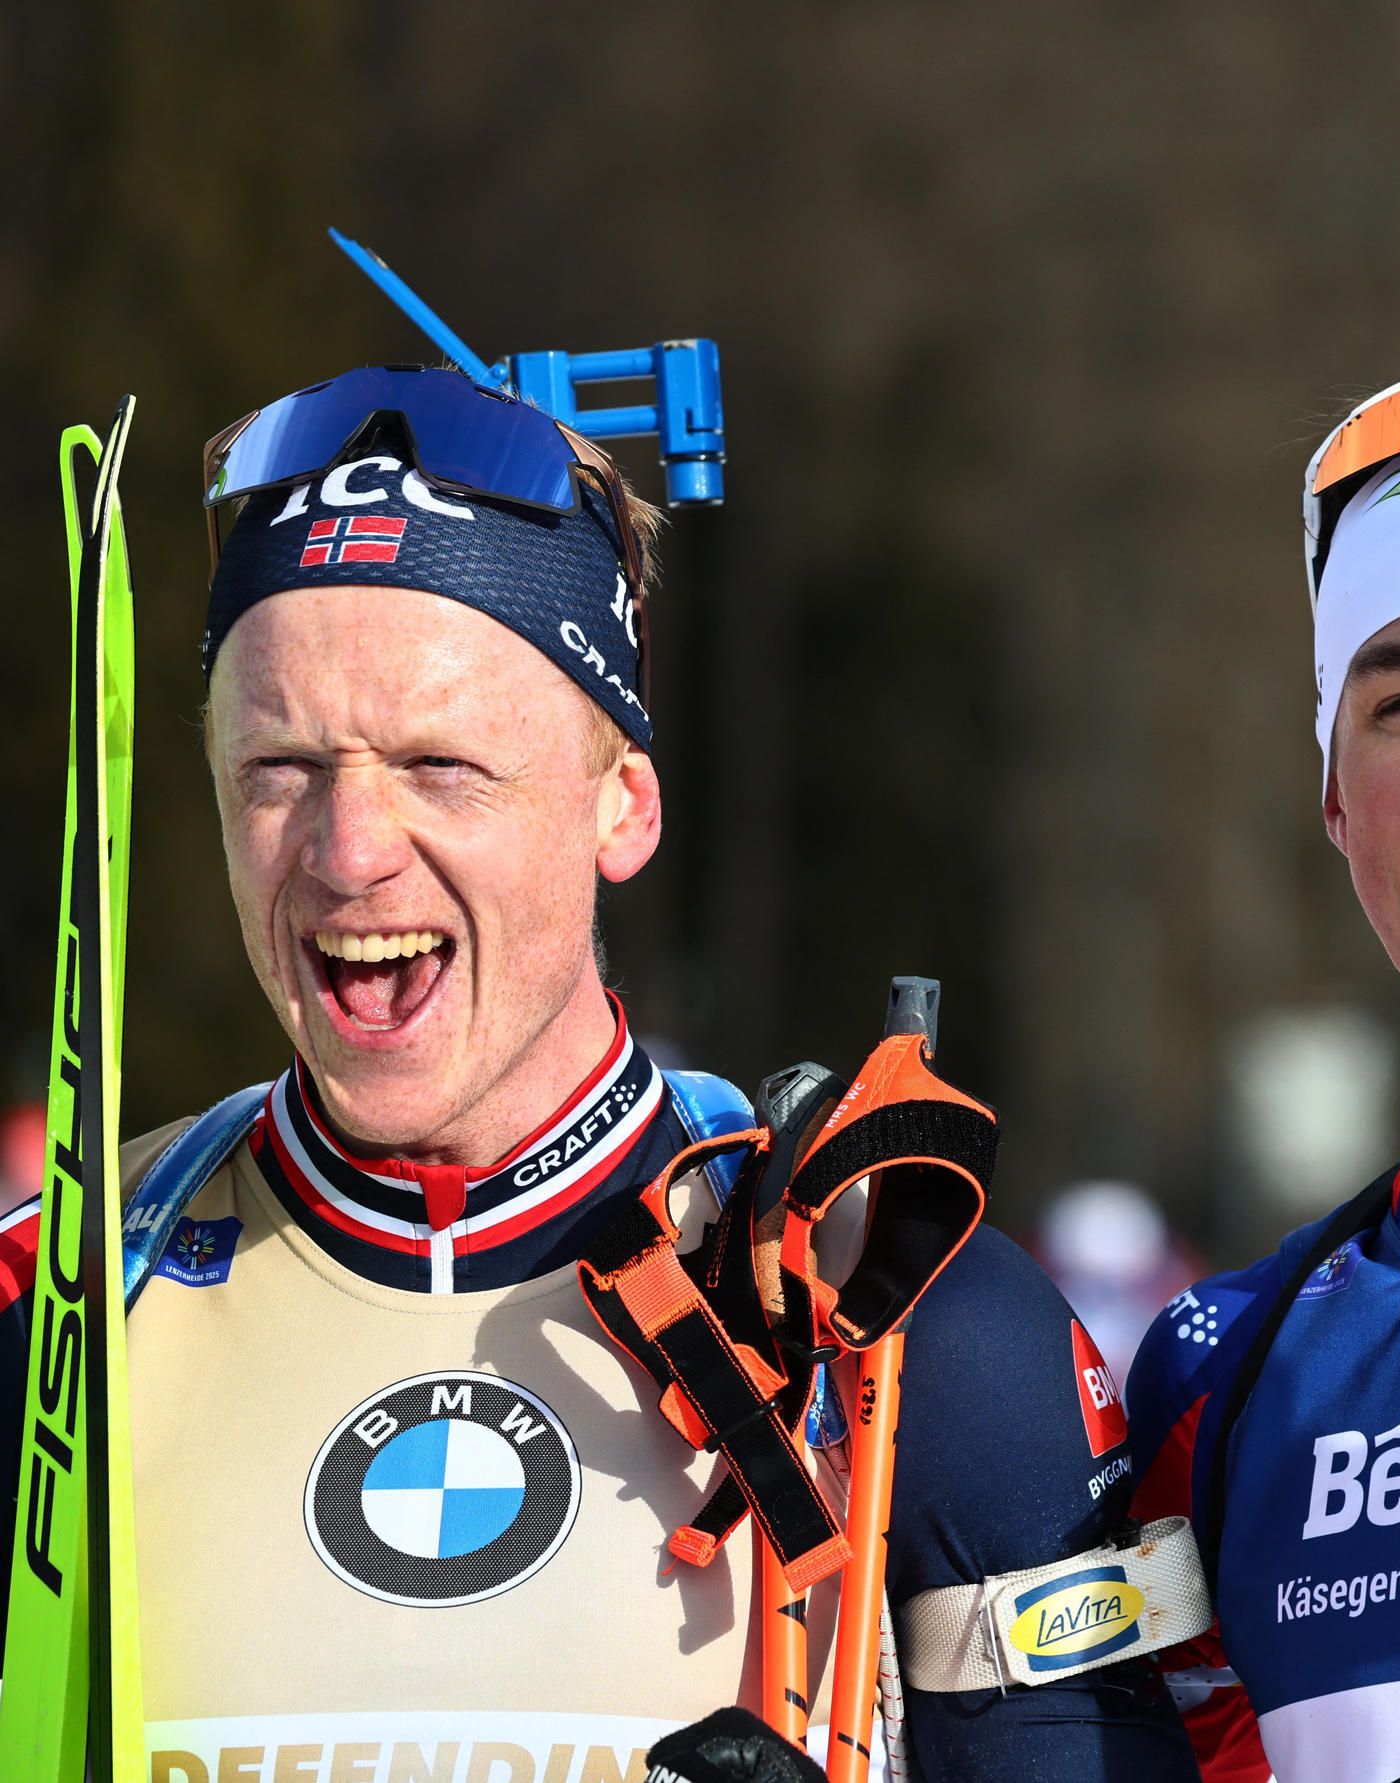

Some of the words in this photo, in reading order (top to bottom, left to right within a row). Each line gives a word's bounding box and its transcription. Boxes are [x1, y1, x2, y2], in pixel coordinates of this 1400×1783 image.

[825, 1104, 849, 1128] MRS
[846, 1083, 866, 1100] WC
[513, 1100, 614, 1187] CRAFT
[165, 1264, 204, 1282] LENZERHEIDE
[205, 1270, 220, 1280] 2025
[353, 1385, 546, 1449] BMW
